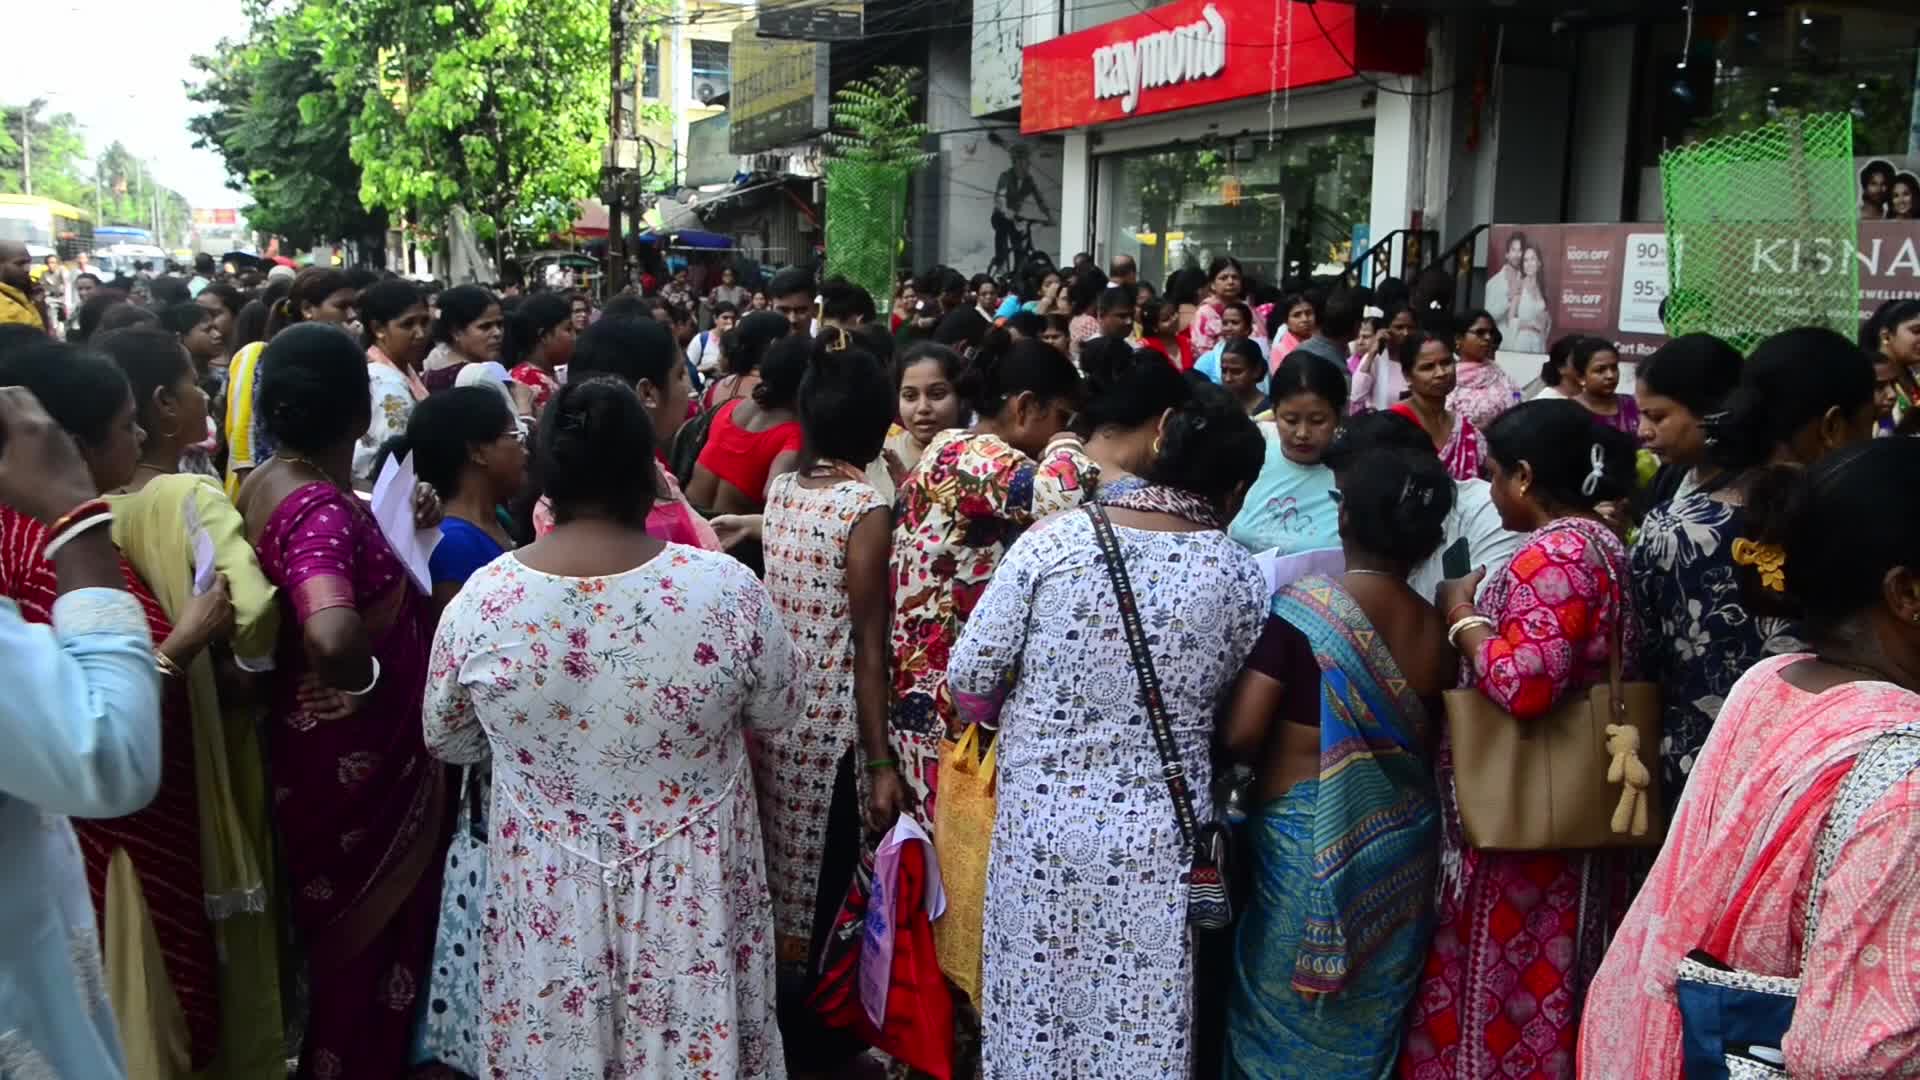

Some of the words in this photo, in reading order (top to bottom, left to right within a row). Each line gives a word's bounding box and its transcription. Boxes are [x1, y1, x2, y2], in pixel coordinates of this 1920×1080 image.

[1591, 250, 1609, 260] OFF
[1751, 237, 1920, 276] KISNA
[1582, 295, 1601, 304] OFF
